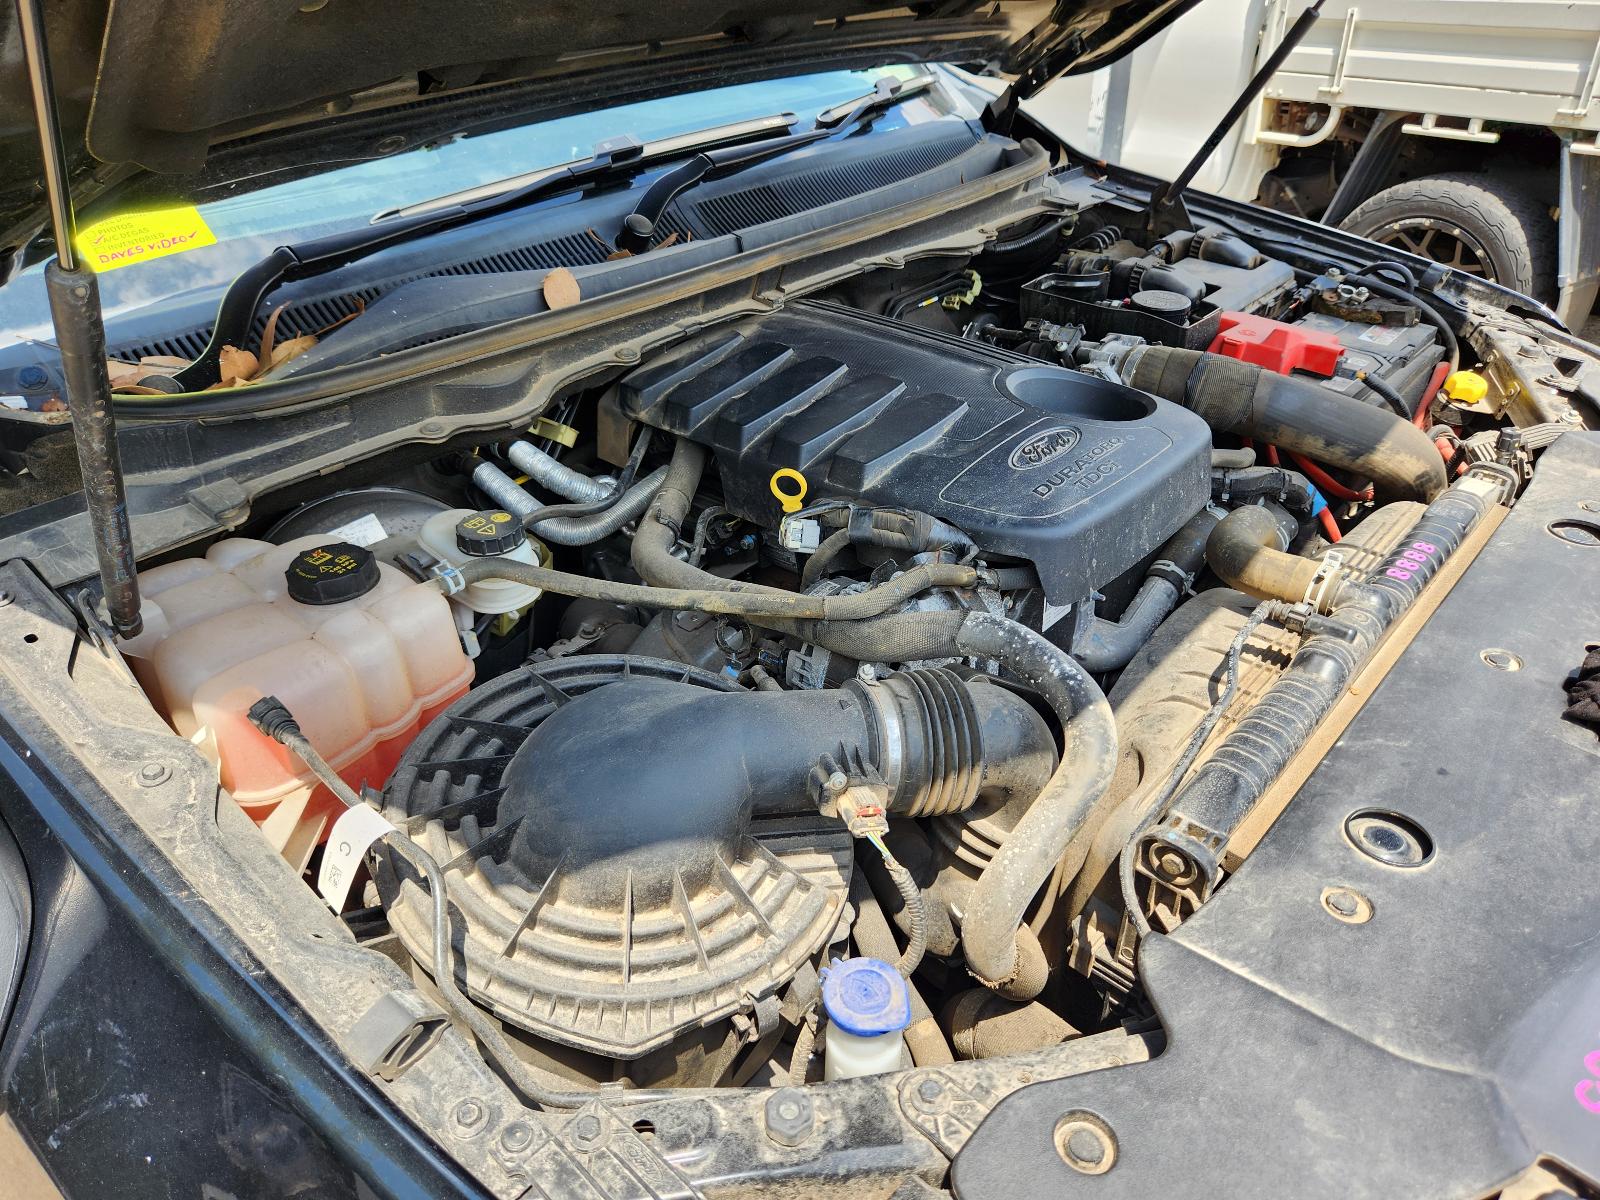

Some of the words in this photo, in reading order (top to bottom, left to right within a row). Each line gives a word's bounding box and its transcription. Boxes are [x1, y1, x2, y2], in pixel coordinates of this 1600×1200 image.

[97, 222, 134, 235] PHOTOS
[120, 227, 150, 239] DEGAS
[98, 245, 145, 264] DAVES
[1021, 433, 1071, 463] Ford
[1032, 436, 1122, 498] DURATORQ
